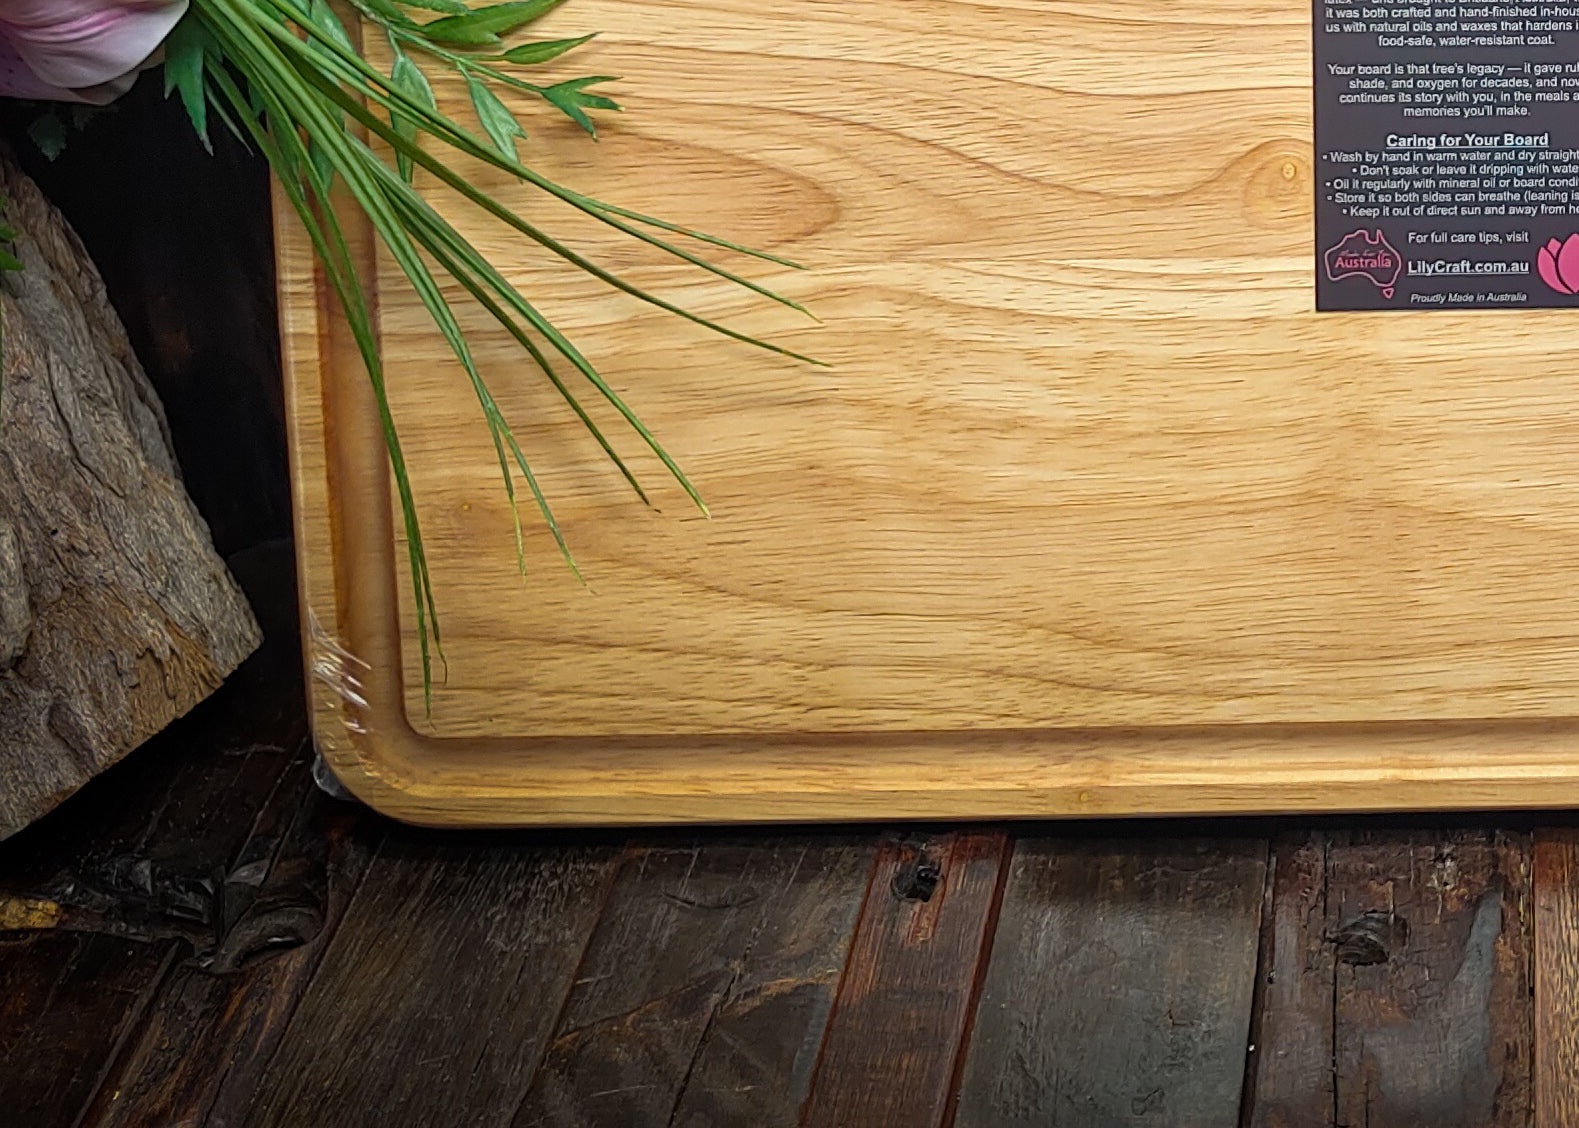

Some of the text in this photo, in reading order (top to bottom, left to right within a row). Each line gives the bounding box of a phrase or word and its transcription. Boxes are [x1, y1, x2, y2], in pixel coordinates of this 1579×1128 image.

[1325, 6, 1333, 19] it
[1335, 9, 1359, 19] was
[1362, 6, 1388, 19] both
[1390, 6, 1431, 18] crafted
[1434, 6, 1456, 18] and
[1459, 5, 1537, 18] hand-finished
[1438, 34, 1524, 46] water-resistant
[1526, 34, 1555, 46] coat.
[1327, 63, 1355, 75] Your
[1357, 63, 1391, 75] board
[1394, 63, 1404, 75] is
[1406, 63, 1429, 75] that
[1432, 62, 1464, 75] tree's
[1466, 63, 1505, 77] legacy
[1524, 61, 1531, 74] it
[1533, 64, 1562, 76] gave
[1391, 77, 1413, 89] and
[1416, 79, 1458, 91] oxygen
[1461, 76, 1478, 89] for
[1535, 76, 1557, 88] and
[1338, 92, 1395, 104] continues
[1398, 91, 1412, 103] its
[1414, 92, 1443, 105] story
[1445, 90, 1469, 103] with
[1500, 90, 1510, 103] in
[1513, 90, 1532, 102] the
[1535, 90, 1569, 102] meals
[1403, 104, 1530, 119] memories you'll make.
[1386, 132, 1548, 150] Caring for Your Board
[1330, 151, 1362, 163] Wash
[1364, 150, 1379, 165] by
[1381, 150, 1410, 162] hand
[1412, 150, 1423, 162] in
[1425, 152, 1457, 162] warm
[1459, 150, 1491, 162] water
[1494, 149, 1515, 162] and
[1518, 149, 1536, 164] dry
[1538, 149, 1579, 163] straight
[1360, 164, 1389, 176] Don't
[1392, 164, 1419, 176] soak
[1421, 166, 1434, 176] or
[1436, 163, 1466, 176] leave
[1469, 163, 1477, 176] it
[1479, 163, 1523, 178] dripping
[1526, 162, 1549, 175] with
[1350, 205, 1380, 219] Keep
[1382, 205, 1389, 216] it
[1392, 205, 1410, 216] out
[1412, 204, 1424, 216] of
[1426, 204, 1457, 216] direct
[1460, 206, 1481, 216] sun
[1484, 204, 1505, 216] and
[1508, 206, 1538, 218] away
[1540, 203, 1565, 215] from
[1408, 231, 1428, 244] For
[1430, 231, 1447, 244] full
[1450, 233, 1476, 243] care
[1505, 230, 1528, 243] visit
[1335, 254, 1392, 268] Australia
[1407, 260, 1530, 274] LilyCraft.com.au
[1410, 292, 1527, 306] Proudly Made in Australia
